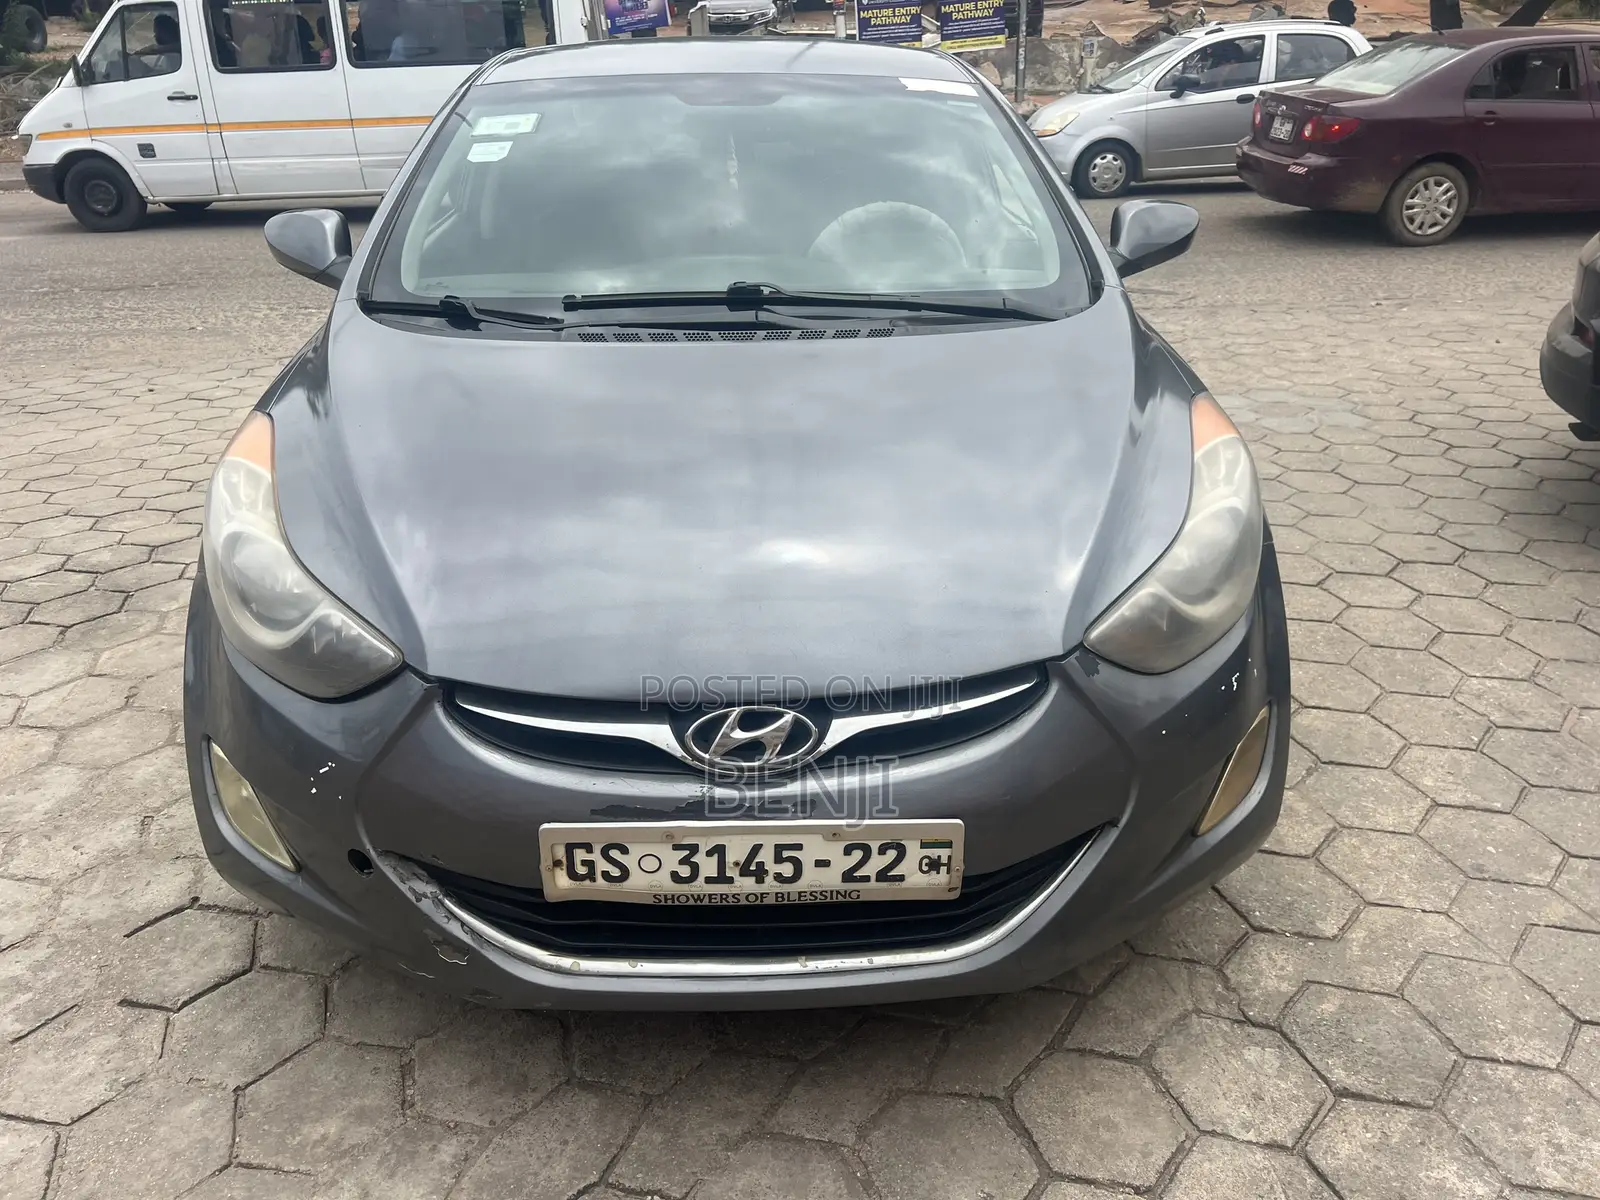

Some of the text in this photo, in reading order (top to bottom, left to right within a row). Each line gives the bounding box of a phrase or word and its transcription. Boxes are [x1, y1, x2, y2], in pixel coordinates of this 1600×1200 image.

[860, 6, 921, 18] MATURE ENTRY
[941, 0, 1005, 13] MATURE ENTRY
[871, 15, 911, 25] PATHWAY
[952, 8, 994, 20] PATHWAY
[565, 842, 630, 883] GS
[652, 889, 861, 904] SHOWERS OF BLESSING
